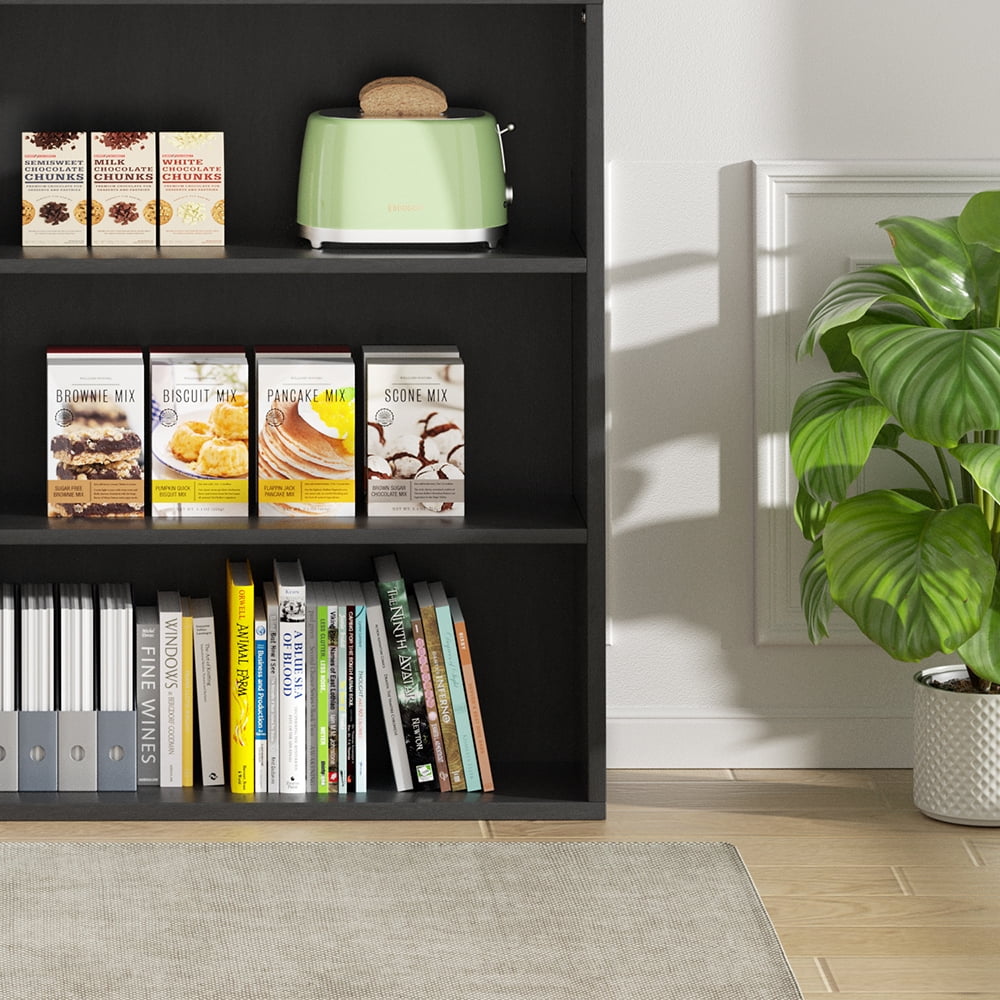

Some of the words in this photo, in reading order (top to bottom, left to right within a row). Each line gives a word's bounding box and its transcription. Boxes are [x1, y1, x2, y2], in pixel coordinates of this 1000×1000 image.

[56, 389, 109, 403] BROWNIE
[115, 389, 135, 403] MIX
[163, 389, 210, 403] BISCUIT
[217, 389, 237, 403] MIX
[267, 389, 319, 403] PANCAKE
[325, 389, 345, 403] MIX
[385, 389, 422, 403] SCONE
[428, 389, 448, 403] MIX
[387, 588, 399, 606] THE
[283, 633, 292, 650] OF
[389, 605, 408, 650] NINTH
[164, 618, 178, 689] WINDOWS
[236, 623, 249, 665] ANIMAL
[294, 643, 303, 674] BLUE
[141, 646, 155, 690] FINE
[236, 669, 249, 697] FARM
[283, 652, 292, 697] BLOOD
[397, 654, 417, 703] AVATAR
[294, 676, 303, 699] SEA
[167, 697, 175, 724] BERGDORF
[257, 687, 265, 727] Production
[141, 699, 155, 764] WINES
[167, 725, 175, 755] GOODMAN
[410, 718, 424, 751] NEWTON
